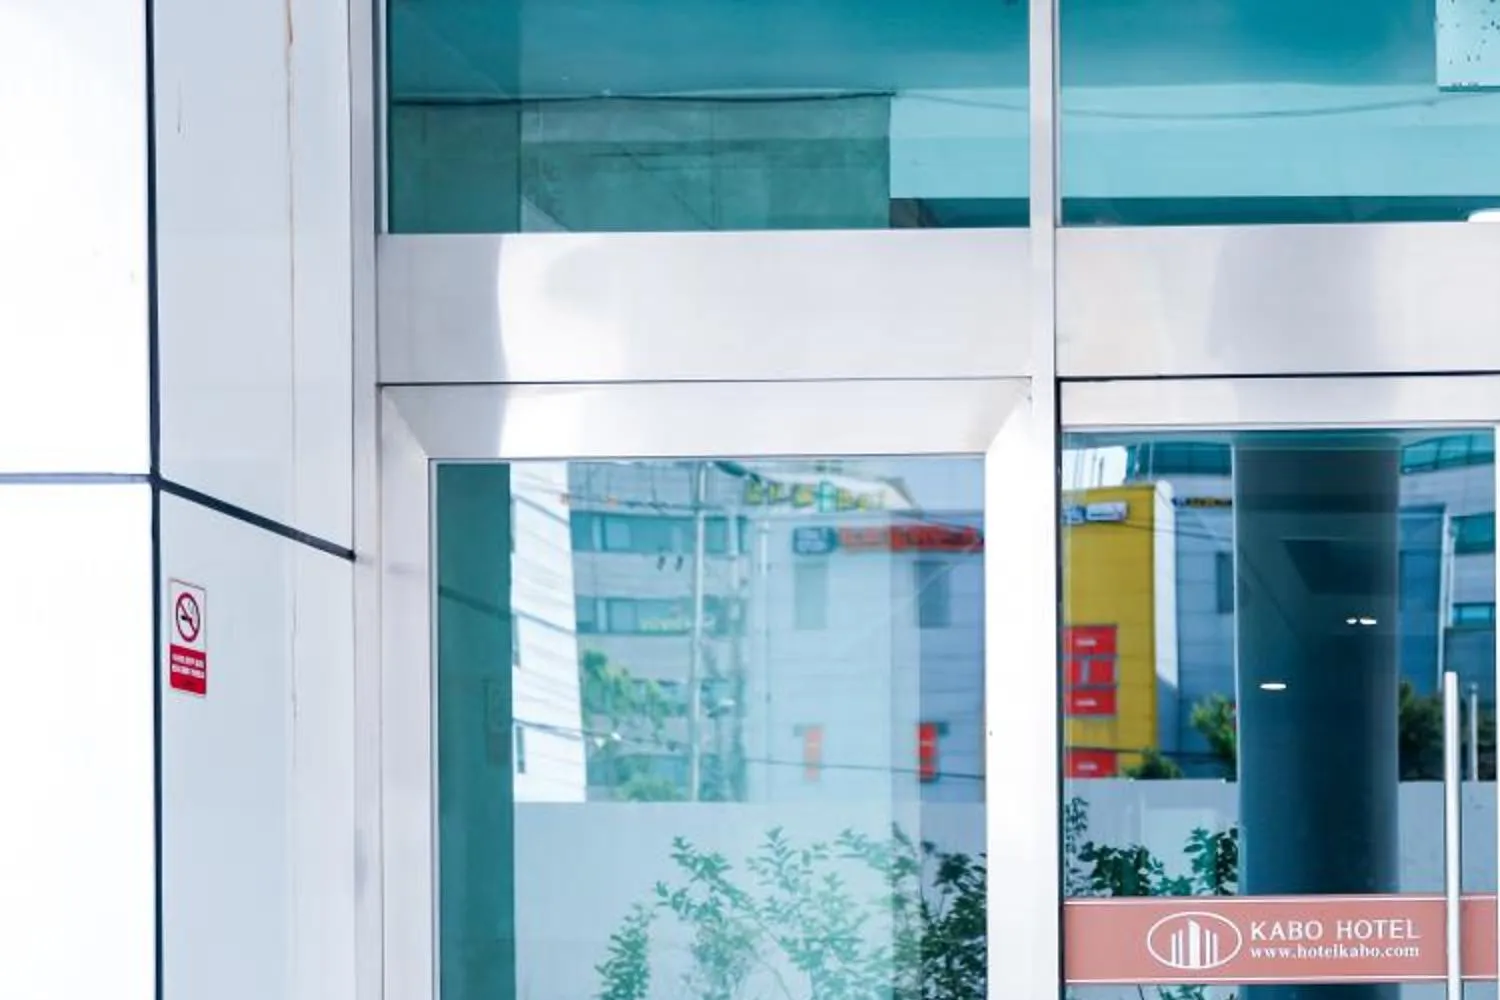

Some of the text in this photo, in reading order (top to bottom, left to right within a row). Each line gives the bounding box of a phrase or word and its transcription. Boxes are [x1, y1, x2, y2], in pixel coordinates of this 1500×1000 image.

[1250, 918, 1422, 941] KABO HOTEL
[1250, 942, 1420, 959] www.hotelkabo.com
